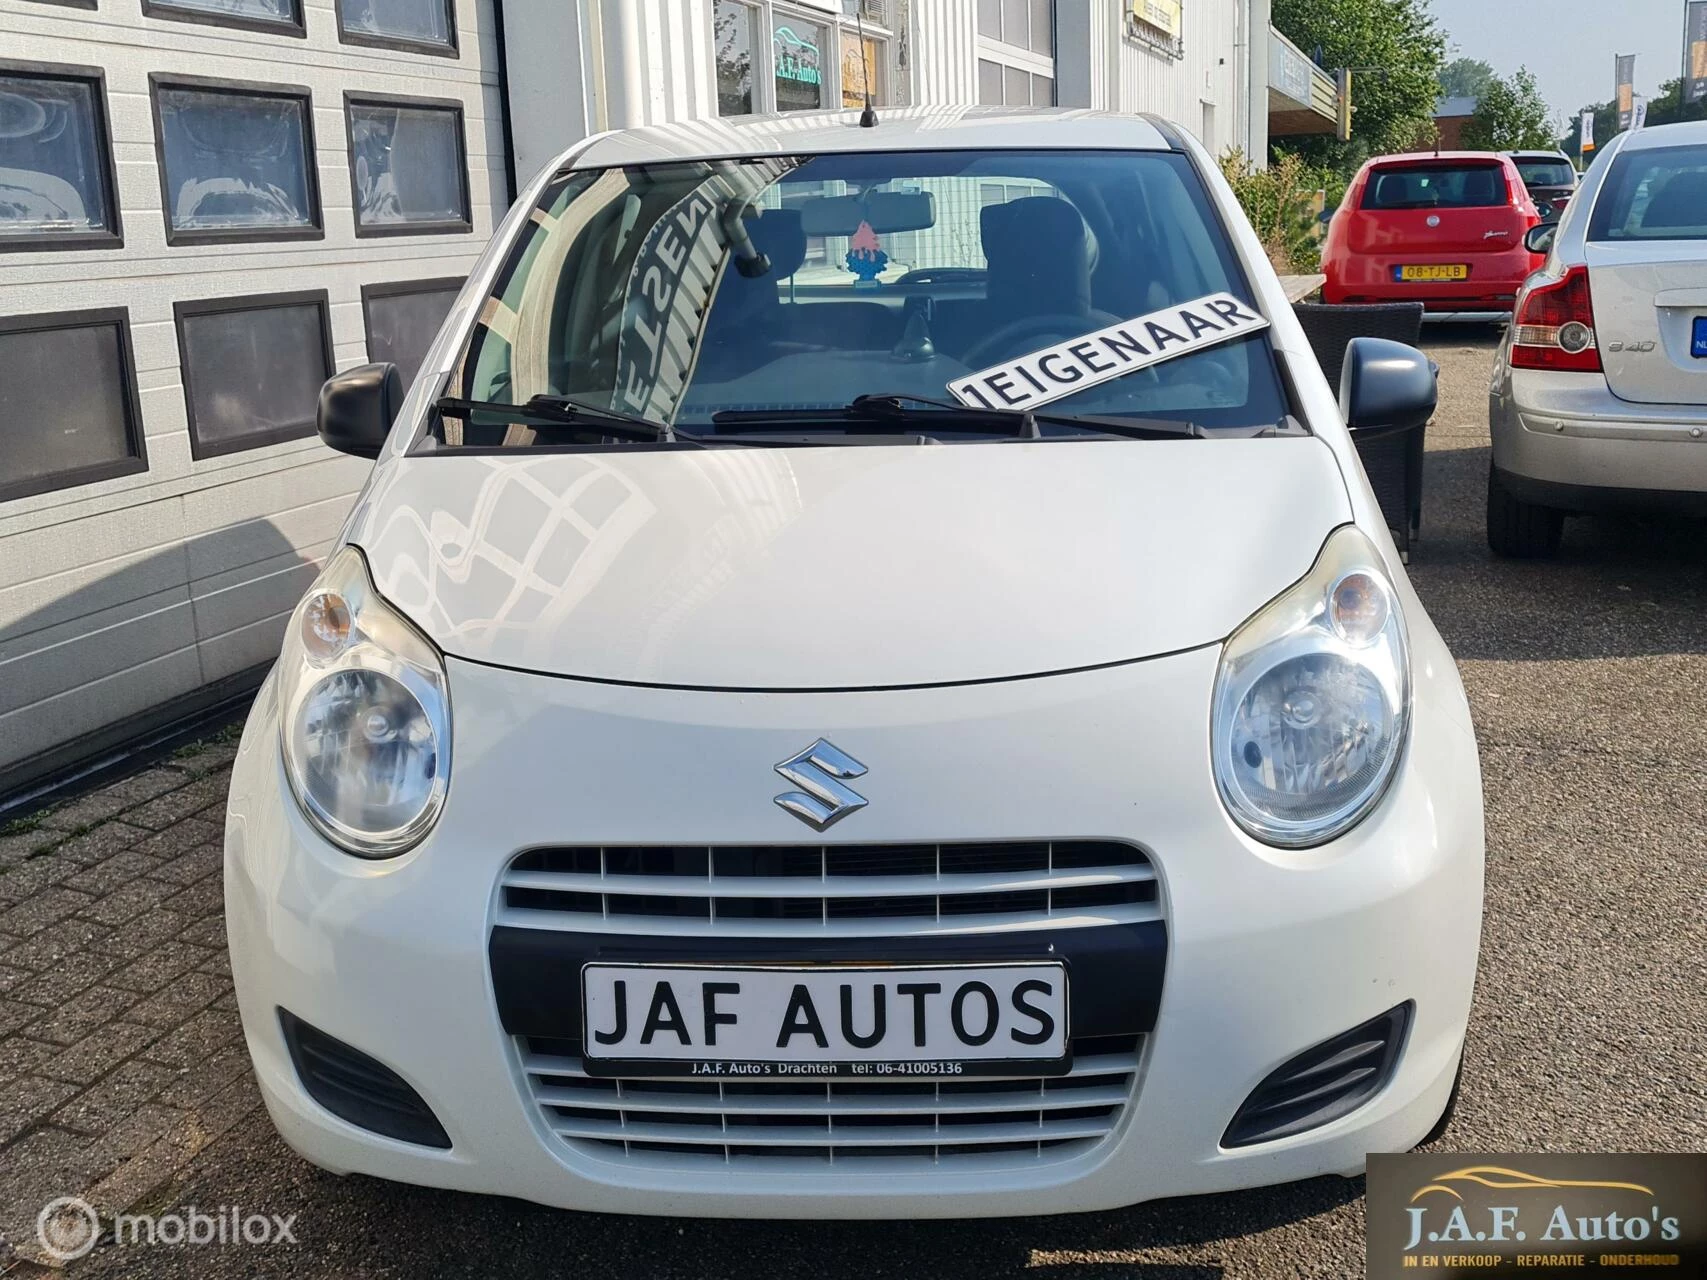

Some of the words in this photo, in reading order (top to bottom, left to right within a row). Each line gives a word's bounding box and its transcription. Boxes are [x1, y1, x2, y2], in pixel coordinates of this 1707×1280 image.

[1407, 266, 1461, 278] 08-TJ-LB
[594, 979, 741, 1047] JAF
[775, 978, 1056, 1050] AUTOS
[691, 1062, 726, 1075] J.A.F.
[728, 1062, 772, 1075] Auto's
[778, 1062, 838, 1075] Drachten
[851, 1062, 873, 1075] tel:
[876, 1062, 963, 1075] 06-41005136
